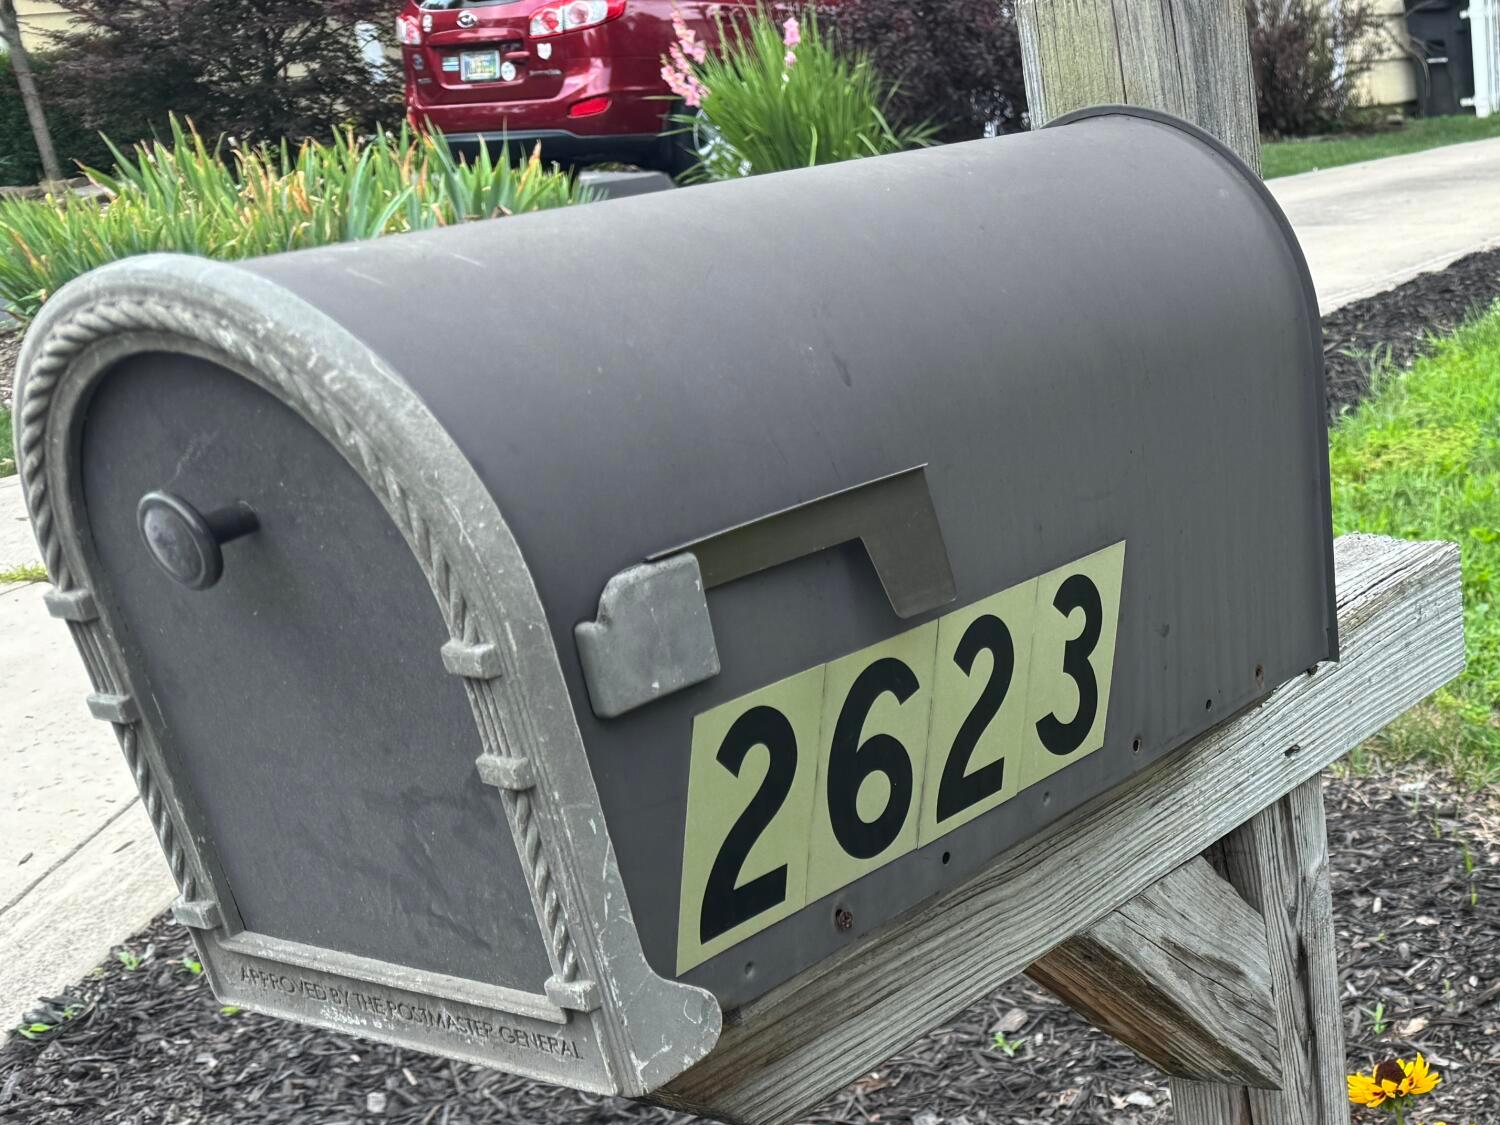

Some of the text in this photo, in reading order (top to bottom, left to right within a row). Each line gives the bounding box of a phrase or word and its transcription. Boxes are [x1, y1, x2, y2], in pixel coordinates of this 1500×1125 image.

[700, 574, 1103, 945] 2623
[240, 966, 584, 1060] APPROVED BY THE POSTMASTER GENERAL
